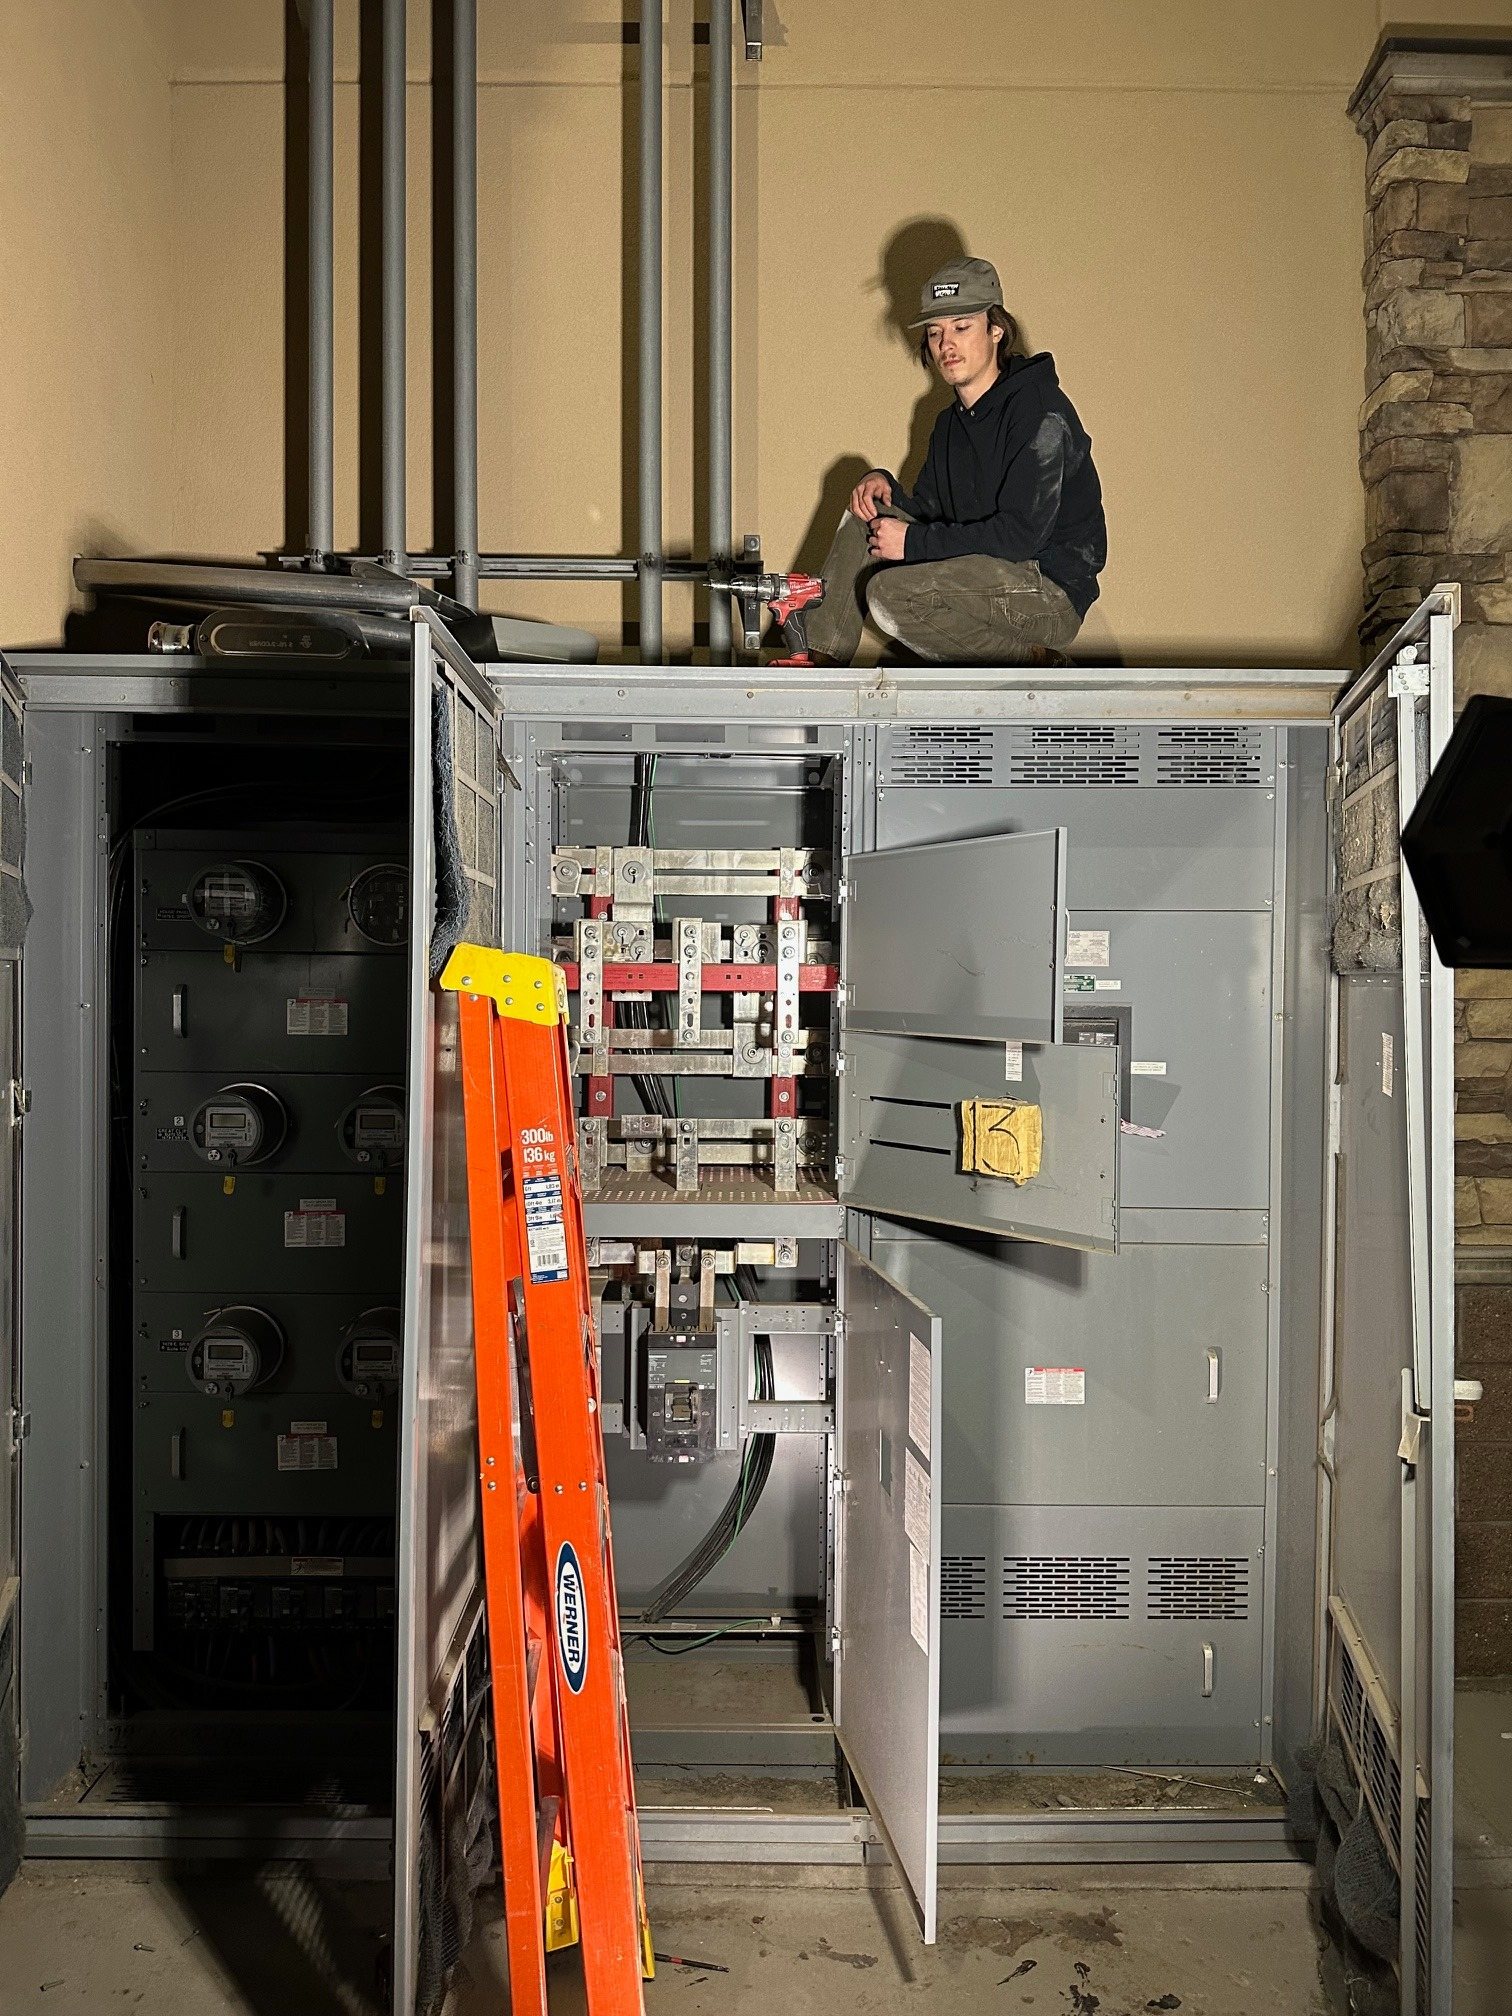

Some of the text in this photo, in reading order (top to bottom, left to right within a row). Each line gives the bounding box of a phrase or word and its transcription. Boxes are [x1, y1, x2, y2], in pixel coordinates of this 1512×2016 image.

[523, 1147, 556, 1163] 136 kg
[969, 1101, 1020, 1175] 13
[174, 1330, 180, 1338] 3
[563, 1573, 580, 1663] WERNER
